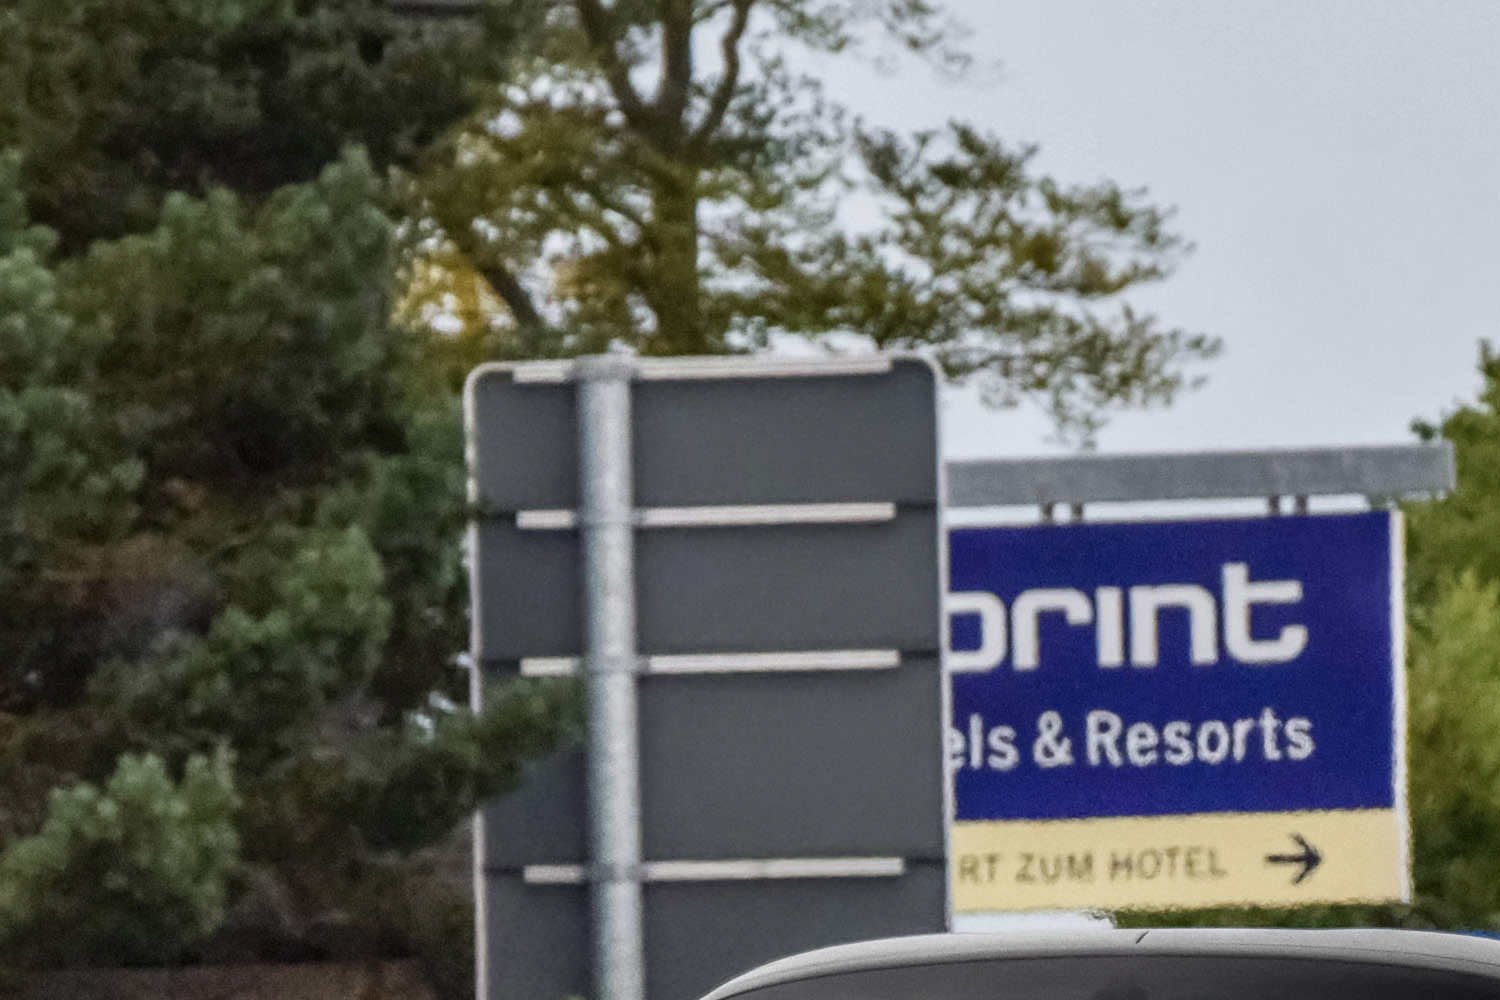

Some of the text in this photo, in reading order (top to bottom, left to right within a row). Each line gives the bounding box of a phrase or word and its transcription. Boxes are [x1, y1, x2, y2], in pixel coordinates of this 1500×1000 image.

[1033, 711, 1073, 768] &
[1086, 708, 1314, 767] Resorts
[1014, 853, 1093, 884] ZUM
[1109, 846, 1227, 881] HOTEL
